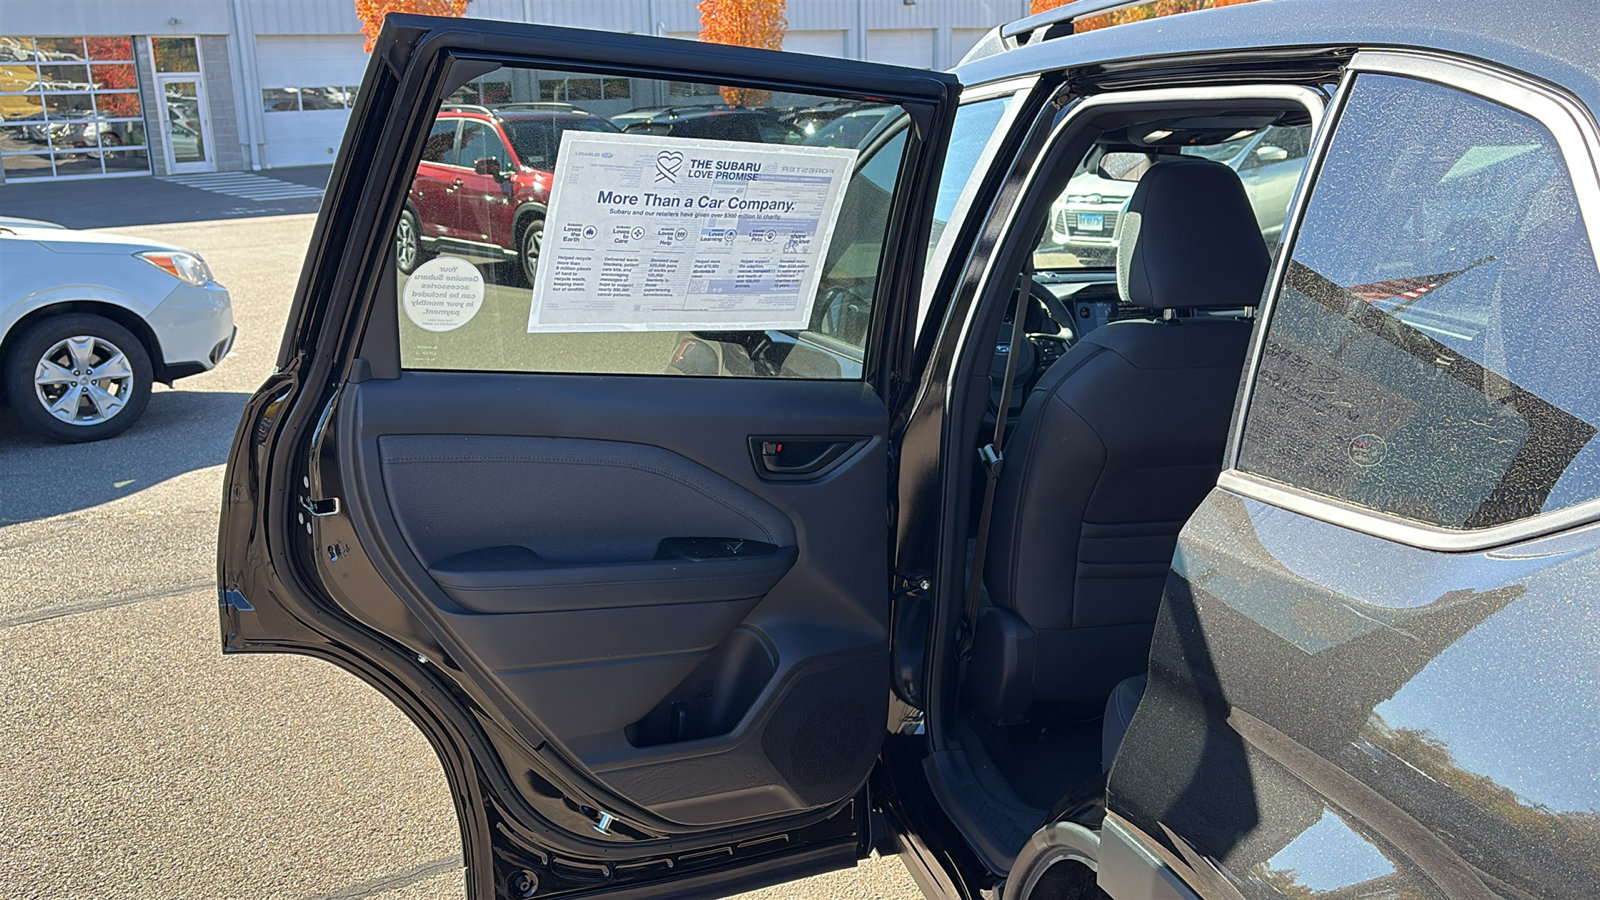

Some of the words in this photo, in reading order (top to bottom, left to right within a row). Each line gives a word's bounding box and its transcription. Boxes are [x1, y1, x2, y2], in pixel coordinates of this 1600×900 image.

[690, 159, 713, 169] THE
[715, 161, 762, 172] SUBARU
[688, 170, 713, 179] LOVE
[715, 171, 760, 181] PROMISE
[597, 190, 639, 206] More
[644, 193, 680, 207] Than
[684, 197, 693, 208] a
[698, 195, 725, 209] Car
[728, 196, 796, 213] Company.
[609, 208, 631, 216] Subaru
